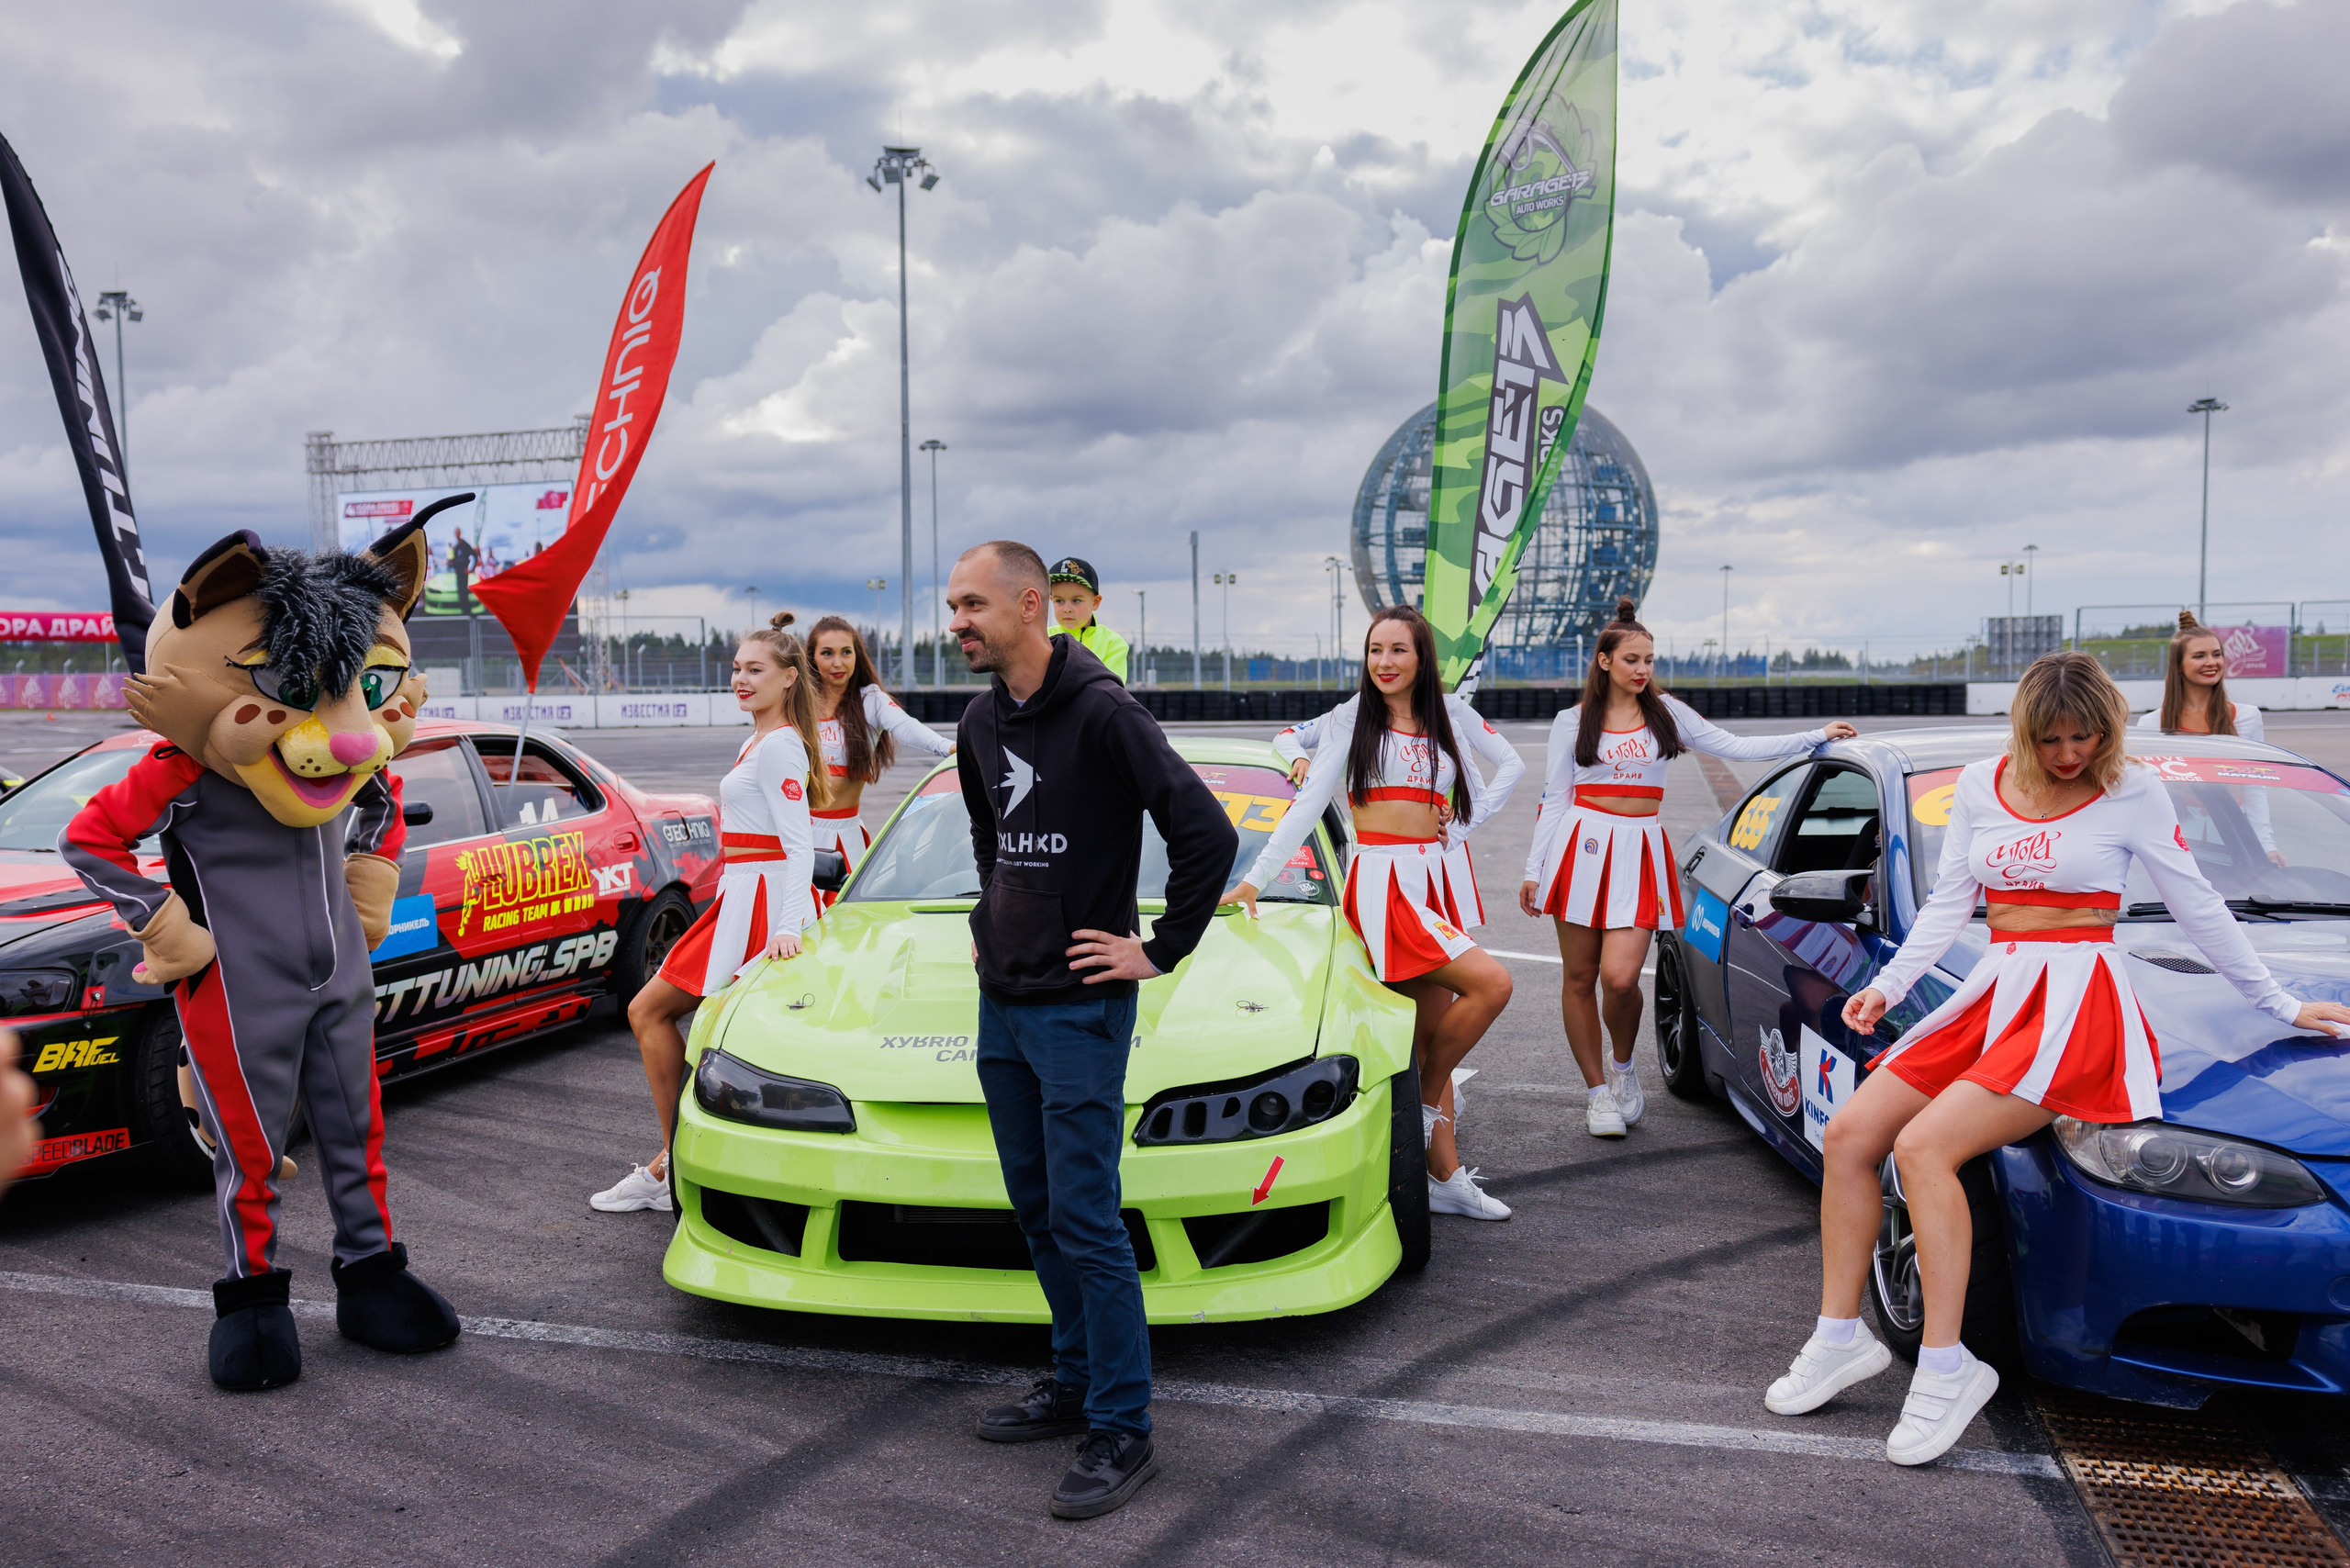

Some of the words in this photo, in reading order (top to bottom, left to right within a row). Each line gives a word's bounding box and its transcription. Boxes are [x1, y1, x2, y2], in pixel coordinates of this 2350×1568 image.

[1516, 202, 1535, 216] AUTO
[1536, 196, 1564, 211] WORKS
[48, 616, 117, 637] ДРАЙ
[1730, 795, 1781, 851] 655
[476, 830, 590, 911] LUBREX
[589, 861, 634, 891] YKT
[483, 908, 520, 932] RACING
[522, 902, 548, 923] TEAM
